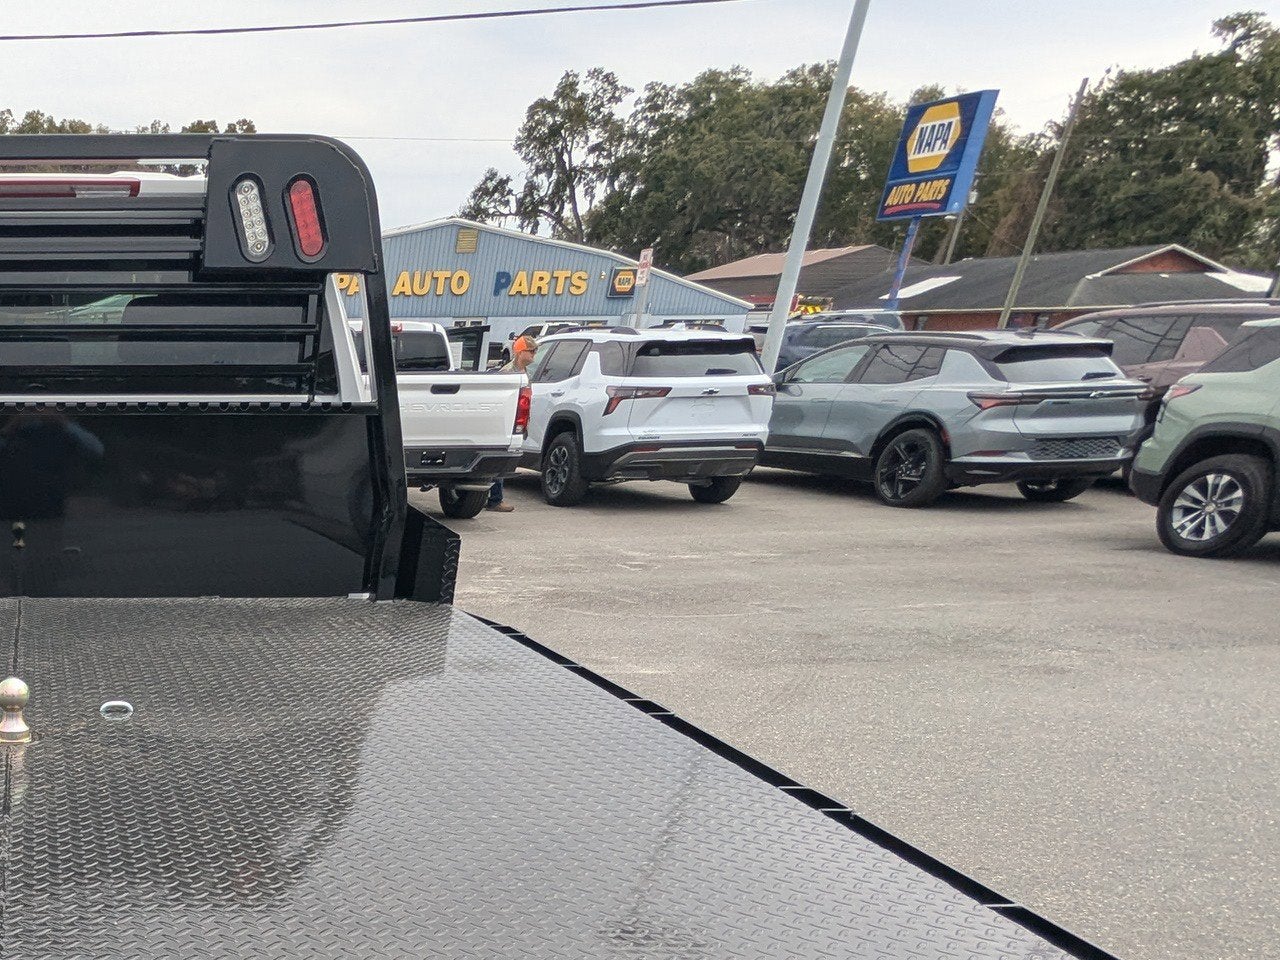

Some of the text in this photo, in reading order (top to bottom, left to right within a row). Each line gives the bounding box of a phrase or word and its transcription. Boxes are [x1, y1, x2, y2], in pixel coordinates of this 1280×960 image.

[912, 120, 955, 156] NAPA
[884, 178, 951, 207] AUTO PARTS
[336, 269, 589, 297] PA AUTO PARTS
[399, 402, 504, 414] HEVROLET
